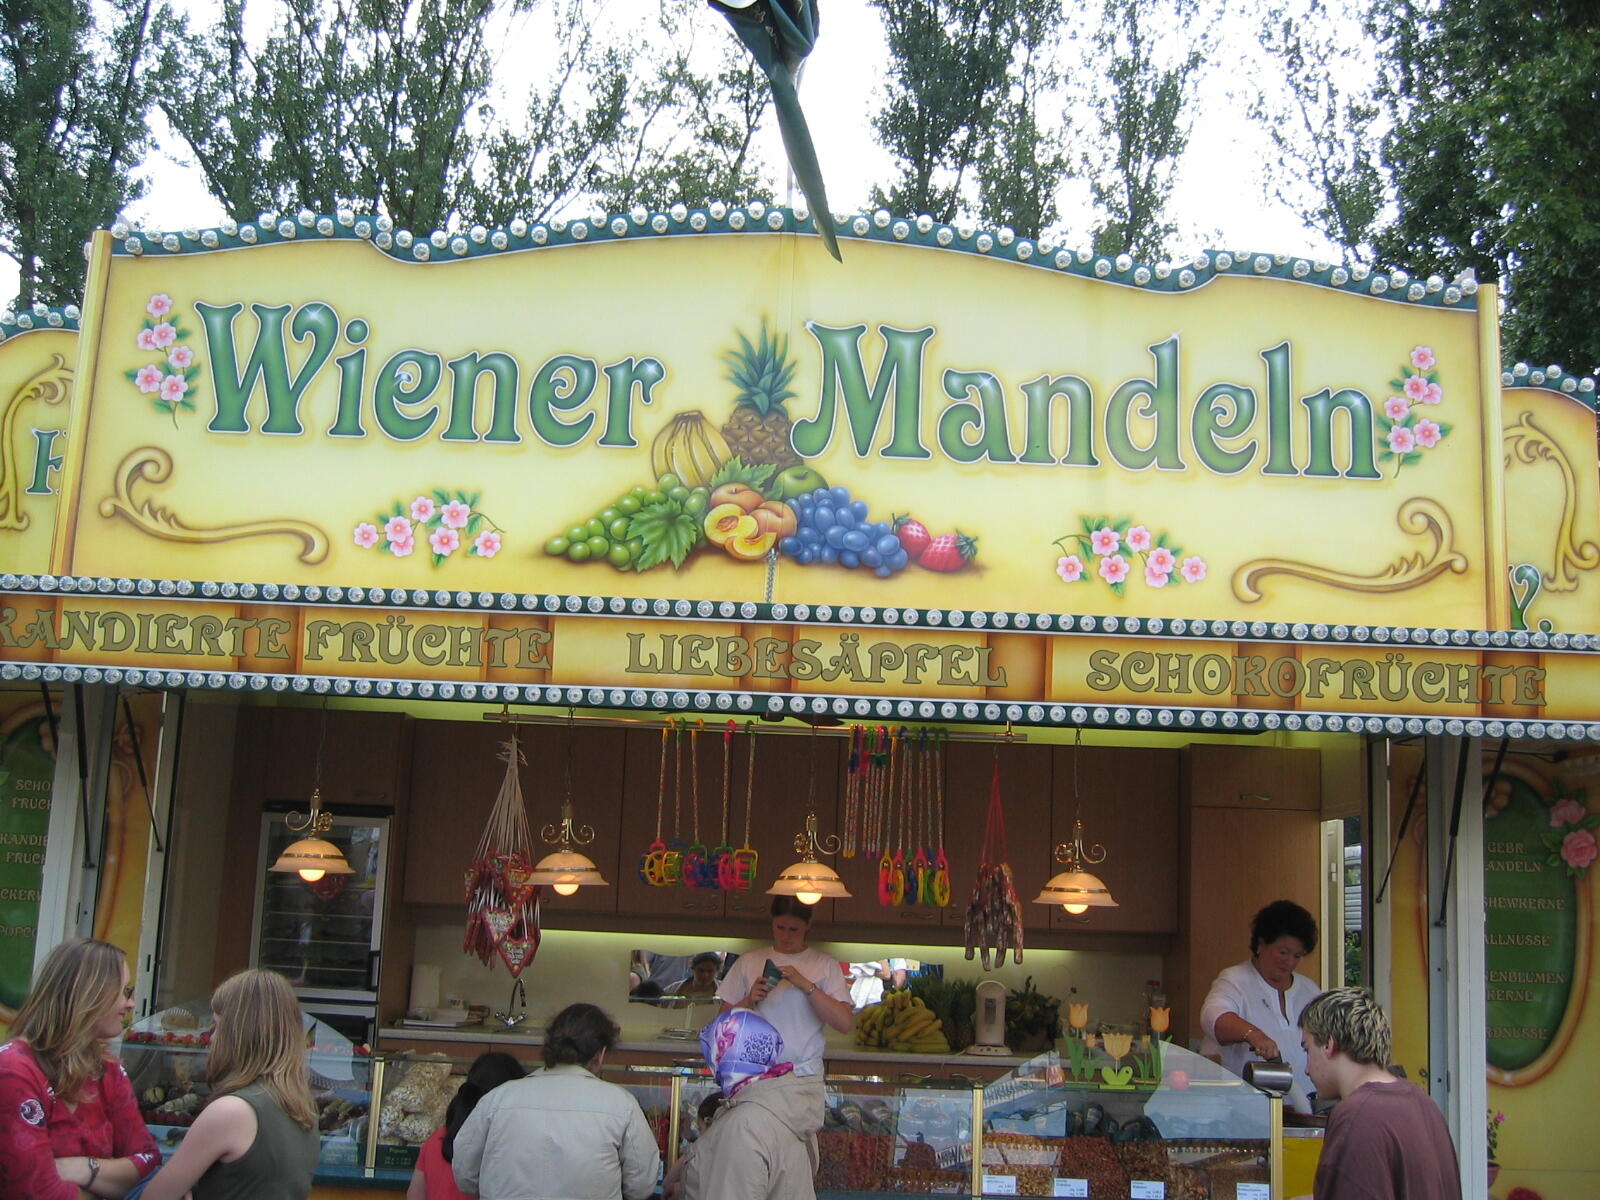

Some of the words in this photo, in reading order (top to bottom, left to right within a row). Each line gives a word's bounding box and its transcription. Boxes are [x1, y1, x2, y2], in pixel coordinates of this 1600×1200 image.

[194, 301, 666, 447] Wiener
[789, 320, 1384, 480] Mandeln
[304, 615, 552, 669] FRÜCHTE
[625, 632, 1008, 687] LIEBESÄPFEL
[1086, 650, 1547, 706] SCHOKOFRÜCHTE
